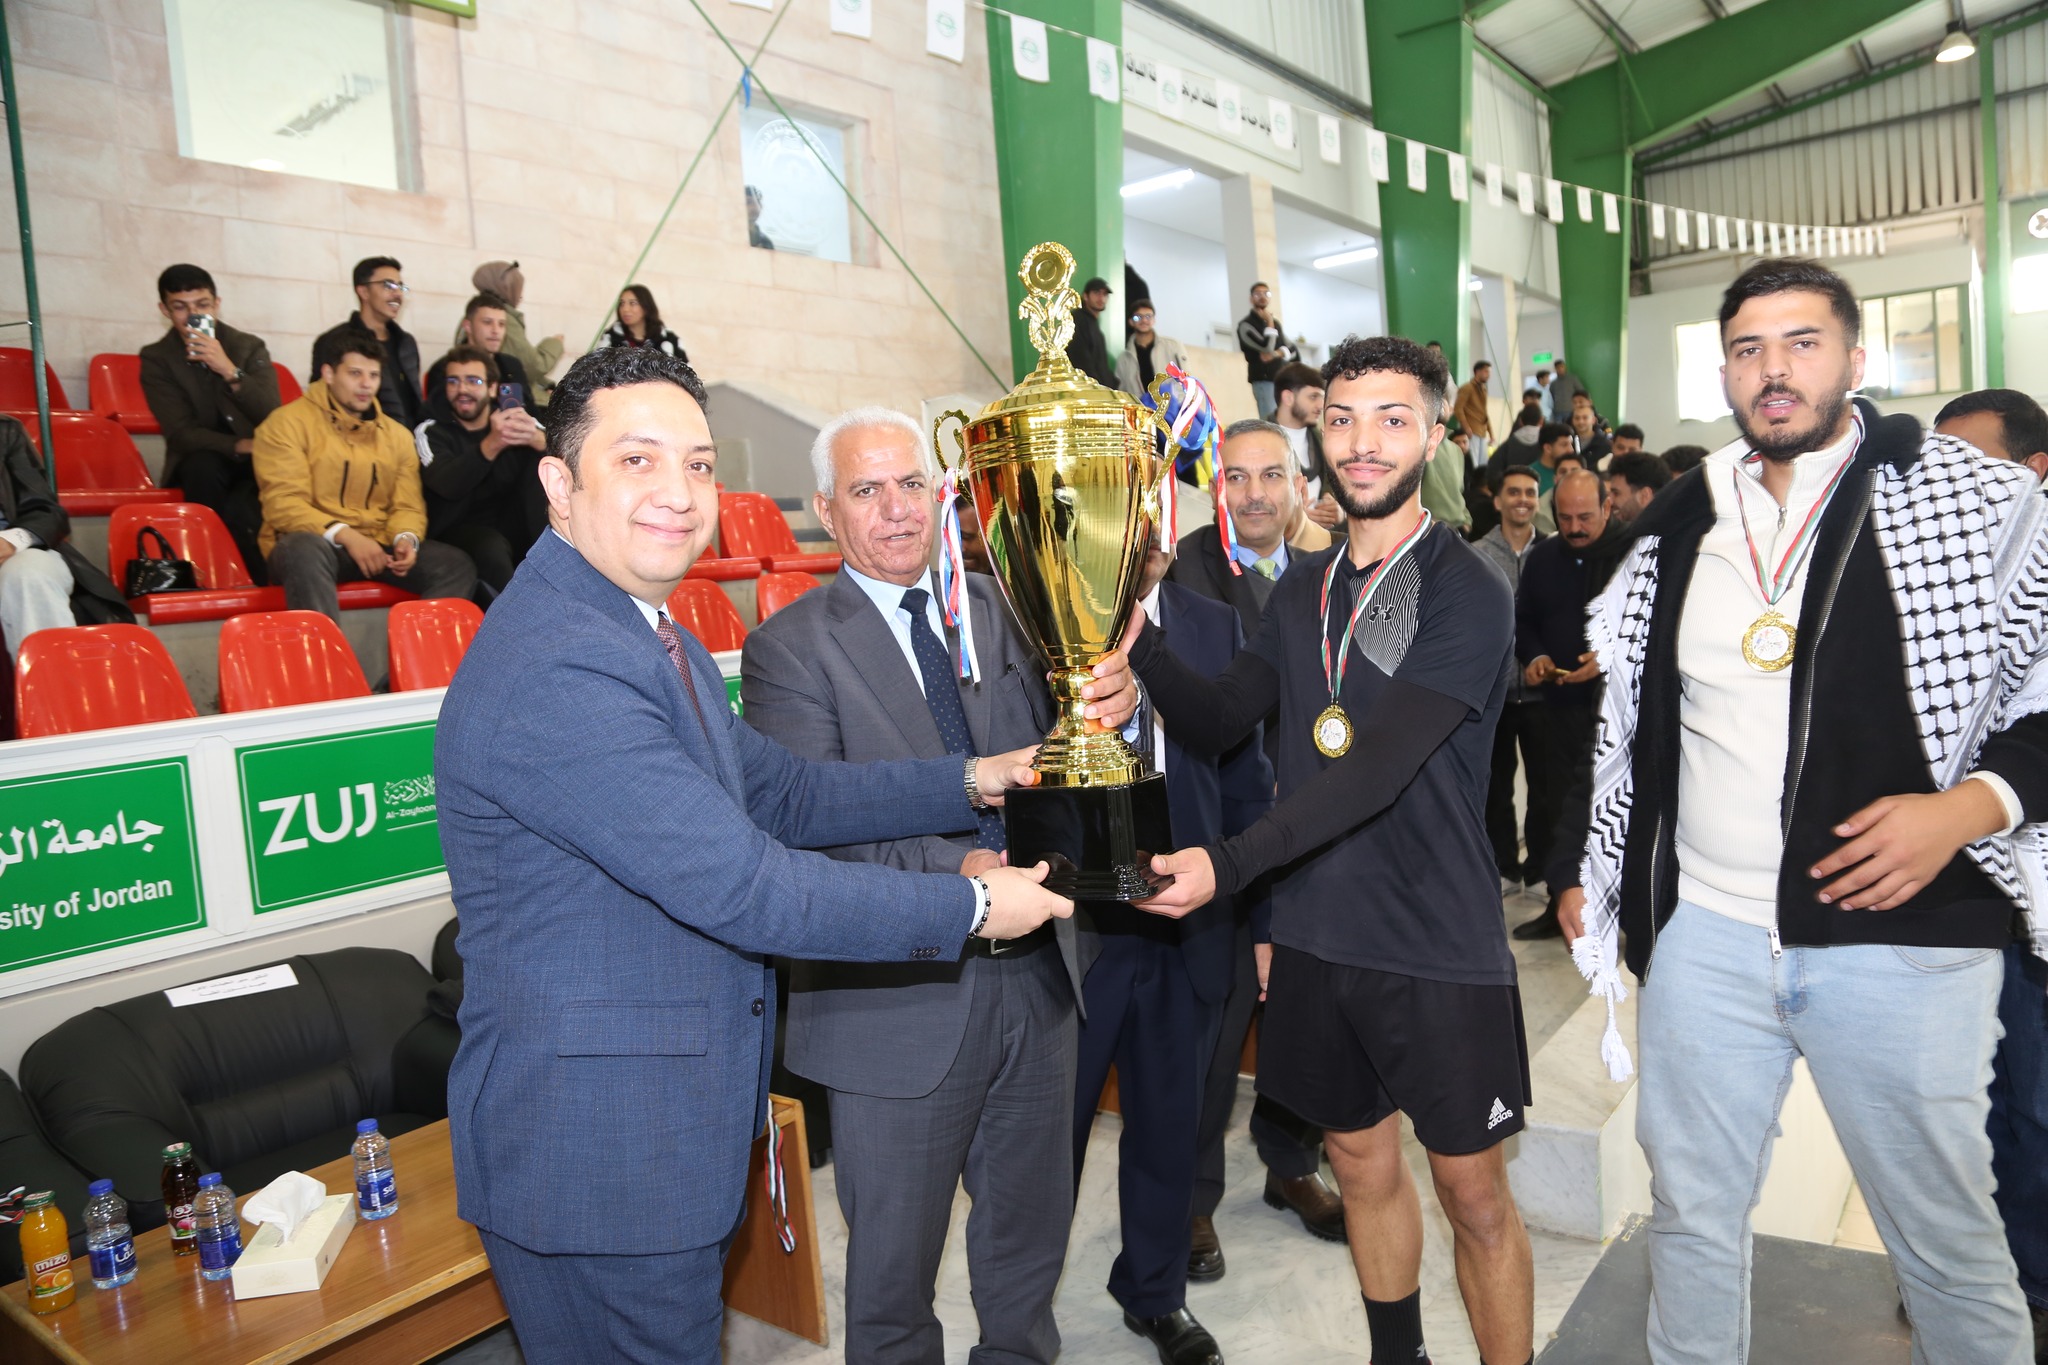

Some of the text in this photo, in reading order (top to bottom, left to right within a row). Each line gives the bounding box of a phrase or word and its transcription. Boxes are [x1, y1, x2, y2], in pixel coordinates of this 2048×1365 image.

[41, 809, 164, 854] جامعة
[258, 783, 377, 856] ZUJ
[54, 891, 80, 918] of
[87, 879, 173, 912] Jordan
[1488, 1109, 1513, 1130] adidas
[34, 1254, 69, 1273] mizo
